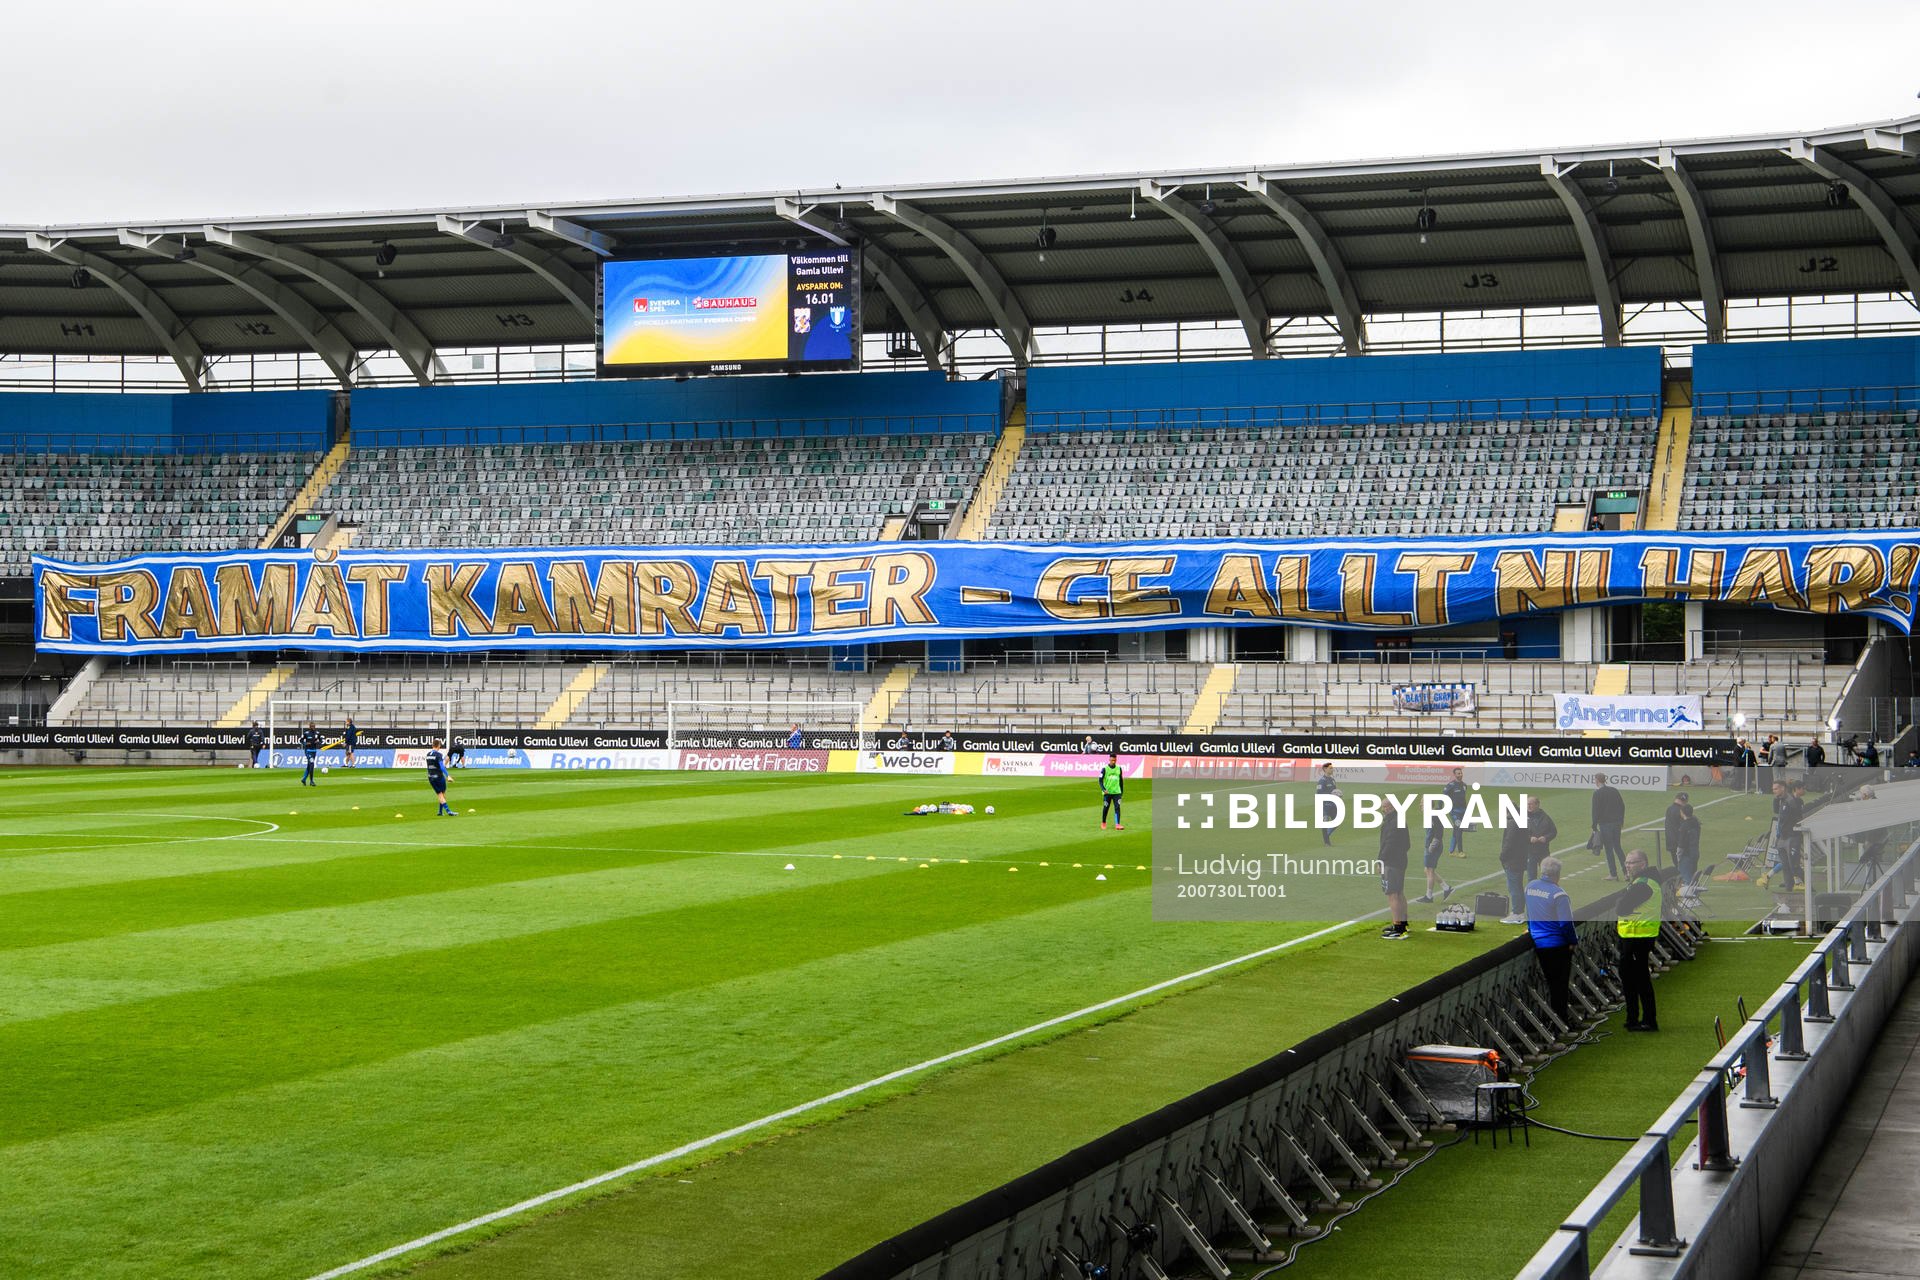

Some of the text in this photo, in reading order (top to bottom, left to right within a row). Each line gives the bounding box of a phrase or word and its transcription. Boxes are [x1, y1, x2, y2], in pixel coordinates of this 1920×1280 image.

[791, 254, 849, 265] Välkommen till
[1799, 257, 1839, 273] J2
[796, 266, 844, 275] Gamla Ullevi
[1463, 273, 1499, 288] J3
[796, 282, 843, 291] AVSPARK OM:
[805, 293, 834, 304] 16.01
[1119, 288, 1154, 302] J4
[703, 298, 756, 308] BAUHAUS
[495, 313, 535, 327] H3
[60, 322, 96, 337] H1
[234, 321, 276, 336] H2
[283, 535, 296, 548] H2
[40, 548, 408, 641] FRAMÅT
[424, 552, 938, 636] KAMRATER
[1036, 555, 1182, 620] GE
[1203, 552, 1474, 626] ALLT
[1496, 548, 1612, 616] NI
[1642, 543, 1920, 615] HAR!
[1558, 696, 1669, 728] Änglarna
[0, 733, 49, 743] amla Ullevi
[54, 733, 114, 744] Gamla Ullevi
[119, 734, 179, 744] Gamla Ullevi
[184, 734, 245, 745] Gamla Ullevi
[386, 735, 418, 745] Gamla
[454, 736, 518, 746] Gamla Ullevi
[523, 736, 589, 747] Gamla Ullevi
[594, 737, 660, 748] Gamla Ullevi
[665, 737, 732, 748] Gamla Ullevi
[738, 738, 773, 748] Gamla
[850, 738, 881, 749] Ulevi
[886, 739, 923, 750] Gala
[962, 740, 1034, 751] Gamla Ullevi
[1040, 741, 1078, 752] Gamla
[1119, 742, 1193, 753] Gamla Ullevi
[1200, 742, 1275, 753] Gamla Ullevi
[1282, 743, 1360, 755] Gamla Ullevi
[1366, 744, 1445, 756] Gamla Ullevi
[1451, 745, 1532, 757] Gamla Ullevi
[1539, 746, 1621, 758] Gamla Ullevi
[1628, 746, 1713, 759] Gamla Ullevi
[286, 756, 340, 765] SVESKA
[550, 752, 660, 769] Borohus
[685, 753, 819, 772] Prioritet Finans
[883, 752, 943, 769] weber
[1160, 759, 1292, 780] BAUHAUS
